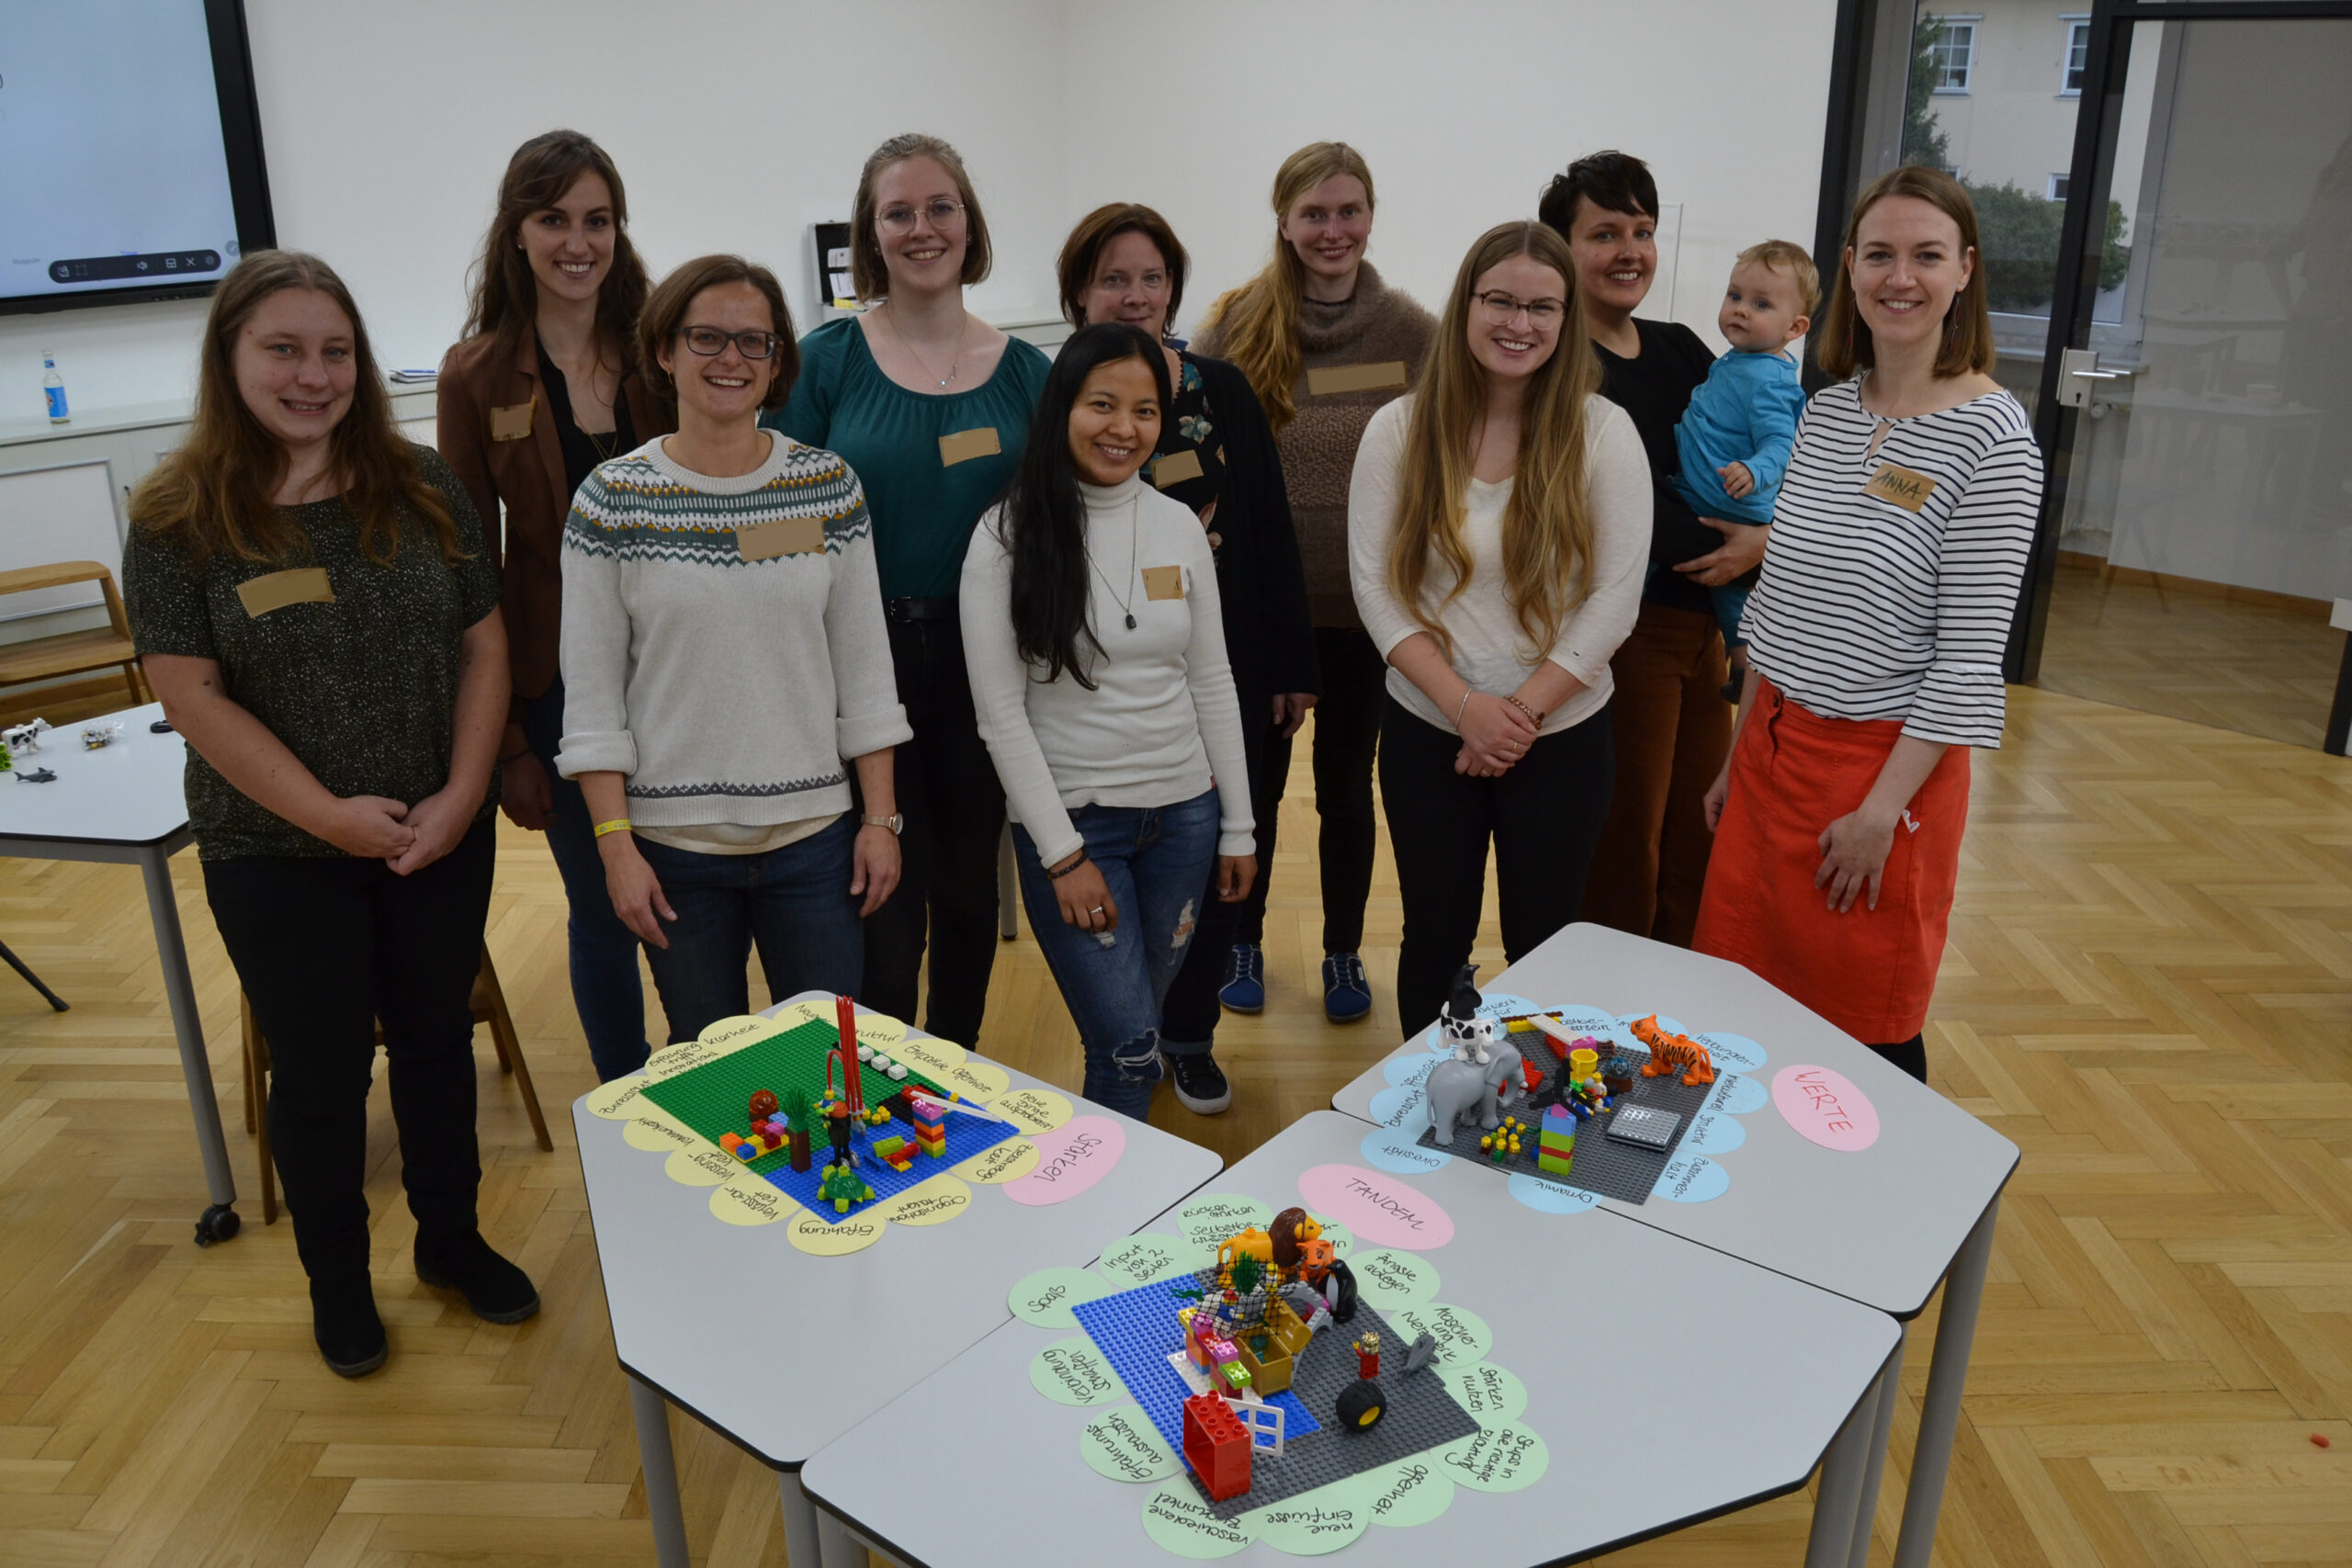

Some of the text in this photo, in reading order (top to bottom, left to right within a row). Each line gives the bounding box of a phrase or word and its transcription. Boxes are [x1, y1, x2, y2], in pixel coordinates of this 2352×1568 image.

[1874, 470, 1921, 500] ANNA
[855, 1027, 900, 1043] ruktur
[1020, 1092, 1046, 1108] neue
[1794, 1071, 1854, 1134] WERTE
[1034, 1134, 1102, 1182] Stärken
[1183, 1204, 1229, 1218] Rücken
[1346, 1178, 1424, 1230] TANDEM
[799, 1221, 874, 1236] Erfahrung
[1104, 1244, 1144, 1269] Input
[1122, 1248, 1164, 1274] von 2
[1376, 1253, 1417, 1281] Ängste
[1364, 1264, 1410, 1293] ablegen
[1027, 1285, 1066, 1314] Spaß
[1476, 1429, 1513, 1483] die richtige
[1499, 1435, 1534, 1479] Stups in
[1305, 1523, 1352, 1534] neue
